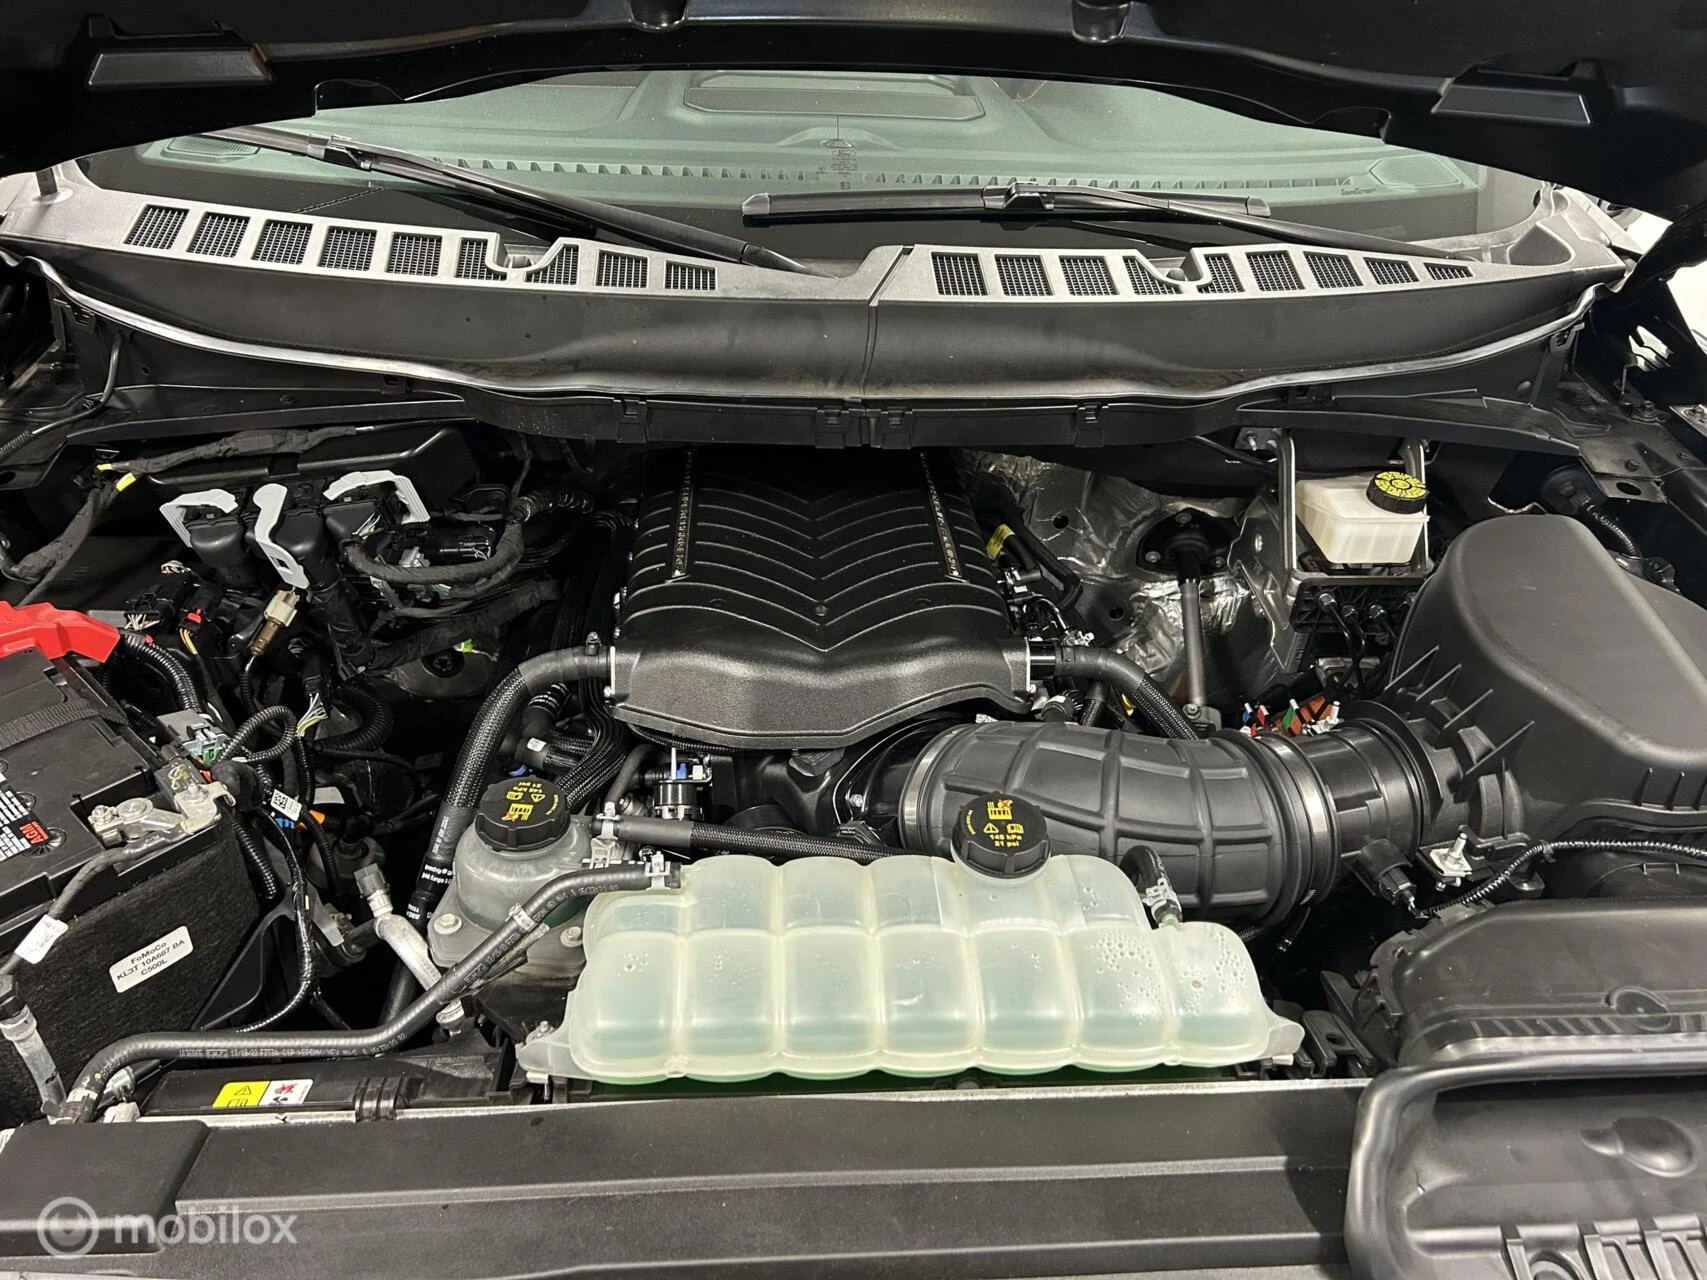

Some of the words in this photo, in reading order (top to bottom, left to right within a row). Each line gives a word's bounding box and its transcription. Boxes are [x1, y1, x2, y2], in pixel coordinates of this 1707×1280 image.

[116, 964, 140, 980] KL3T
[172, 939, 185, 950] BA
[130, 942, 167, 964] FoMoCo
